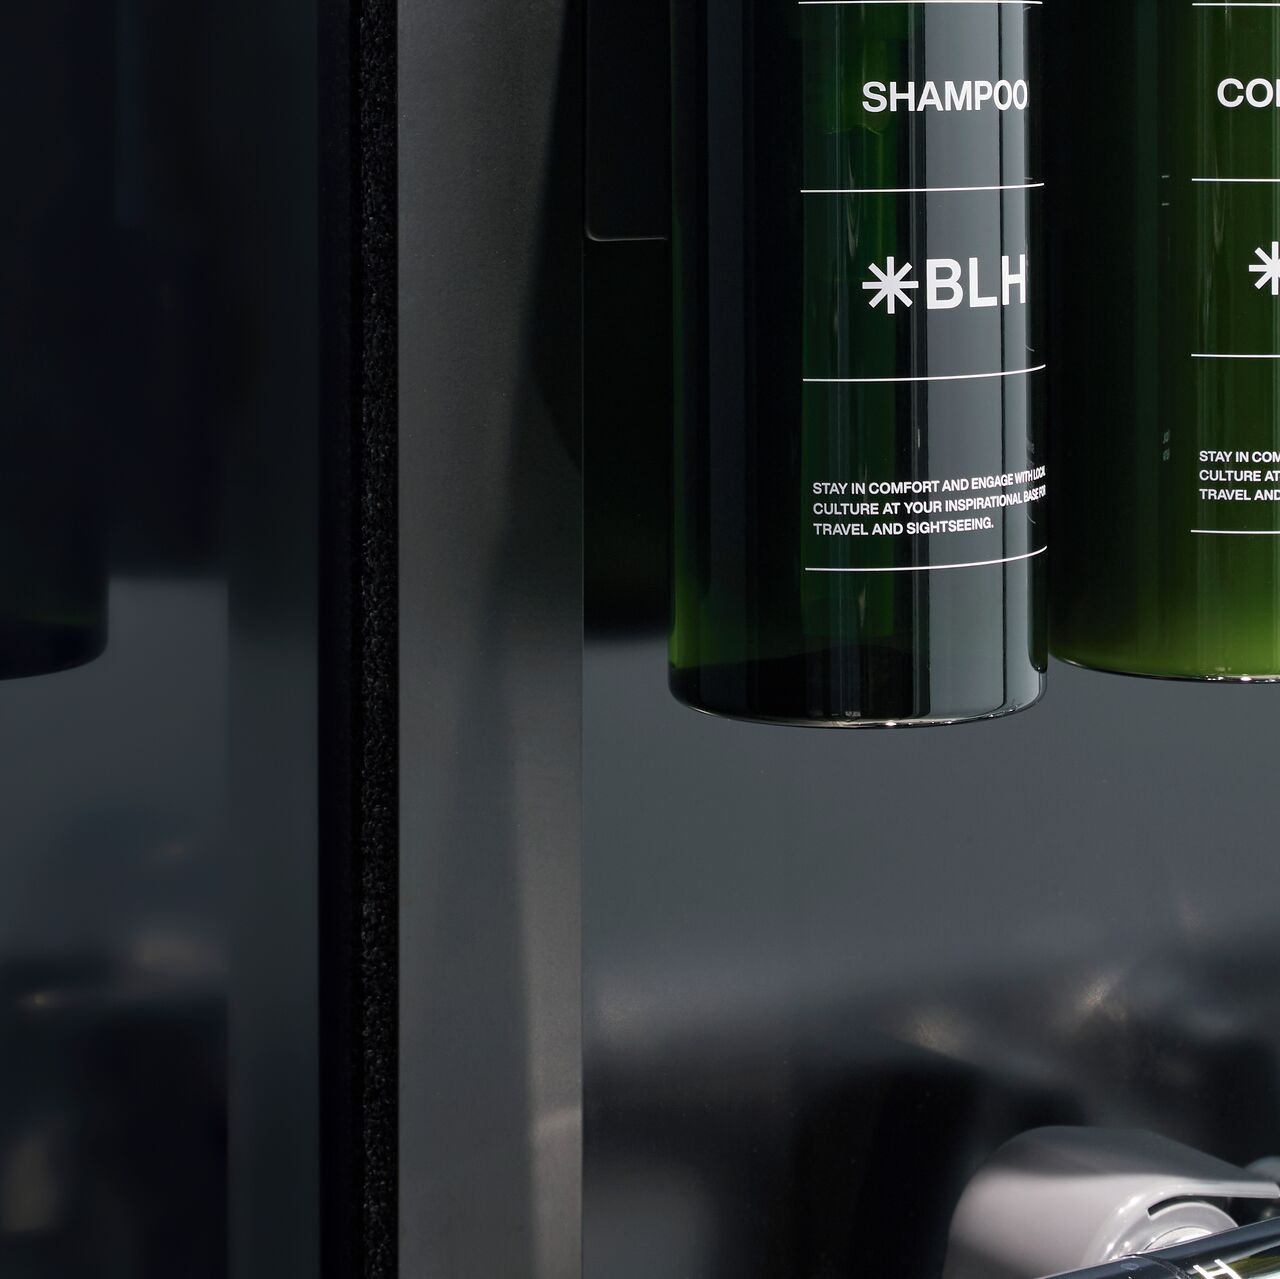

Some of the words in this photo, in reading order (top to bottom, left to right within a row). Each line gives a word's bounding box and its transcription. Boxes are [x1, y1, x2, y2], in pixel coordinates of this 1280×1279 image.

[862, 79, 1029, 113] SHAMPOO
[926, 254, 1026, 310] BLH
[1199, 450, 1233, 463] STAY
[1235, 451, 1249, 463] IN
[812, 482, 848, 495] STAY
[851, 482, 866, 495] IN
[869, 480, 940, 494] COMFORT
[942, 478, 970, 492] AND
[971, 473, 1014, 490] ENGAGE
[1014, 469, 1032, 484] WITH
[1199, 469, 1262, 482] CULTURE
[812, 503, 879, 515] CULTURE
[882, 502, 901, 515] AT
[903, 500, 942, 514] YOUR
[945, 491, 1023, 512] INSPIRATIONAL
[1199, 488, 1252, 501] TRAVEL
[812, 523, 869, 536] TRAVEL
[871, 522, 903, 535] AND
[906, 517, 994, 534] SIGHTSEEING.
